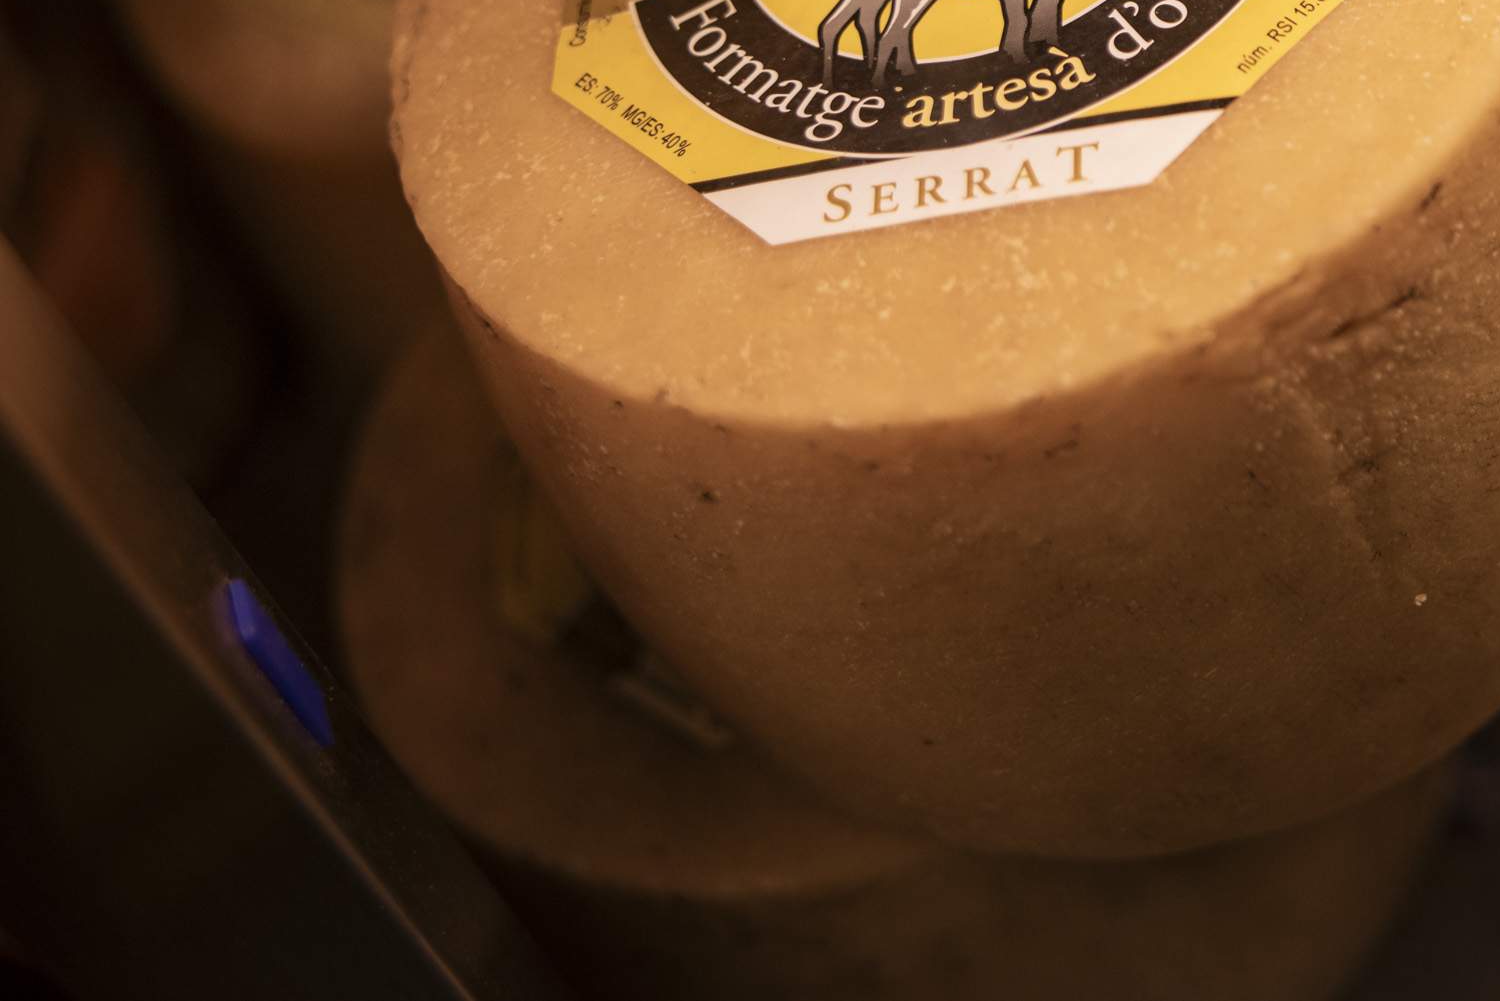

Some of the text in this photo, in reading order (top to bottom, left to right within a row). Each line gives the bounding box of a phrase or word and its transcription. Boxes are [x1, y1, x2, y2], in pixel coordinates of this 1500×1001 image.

[1237, 44, 1273, 74] núm.
[1267, 18, 1298, 43] RSI
[575, 73, 599, 94] ES:
[594, 84, 624, 111] 70%
[903, 46, 1096, 128] artesà
[823, 142, 1100, 223] SERRAT
